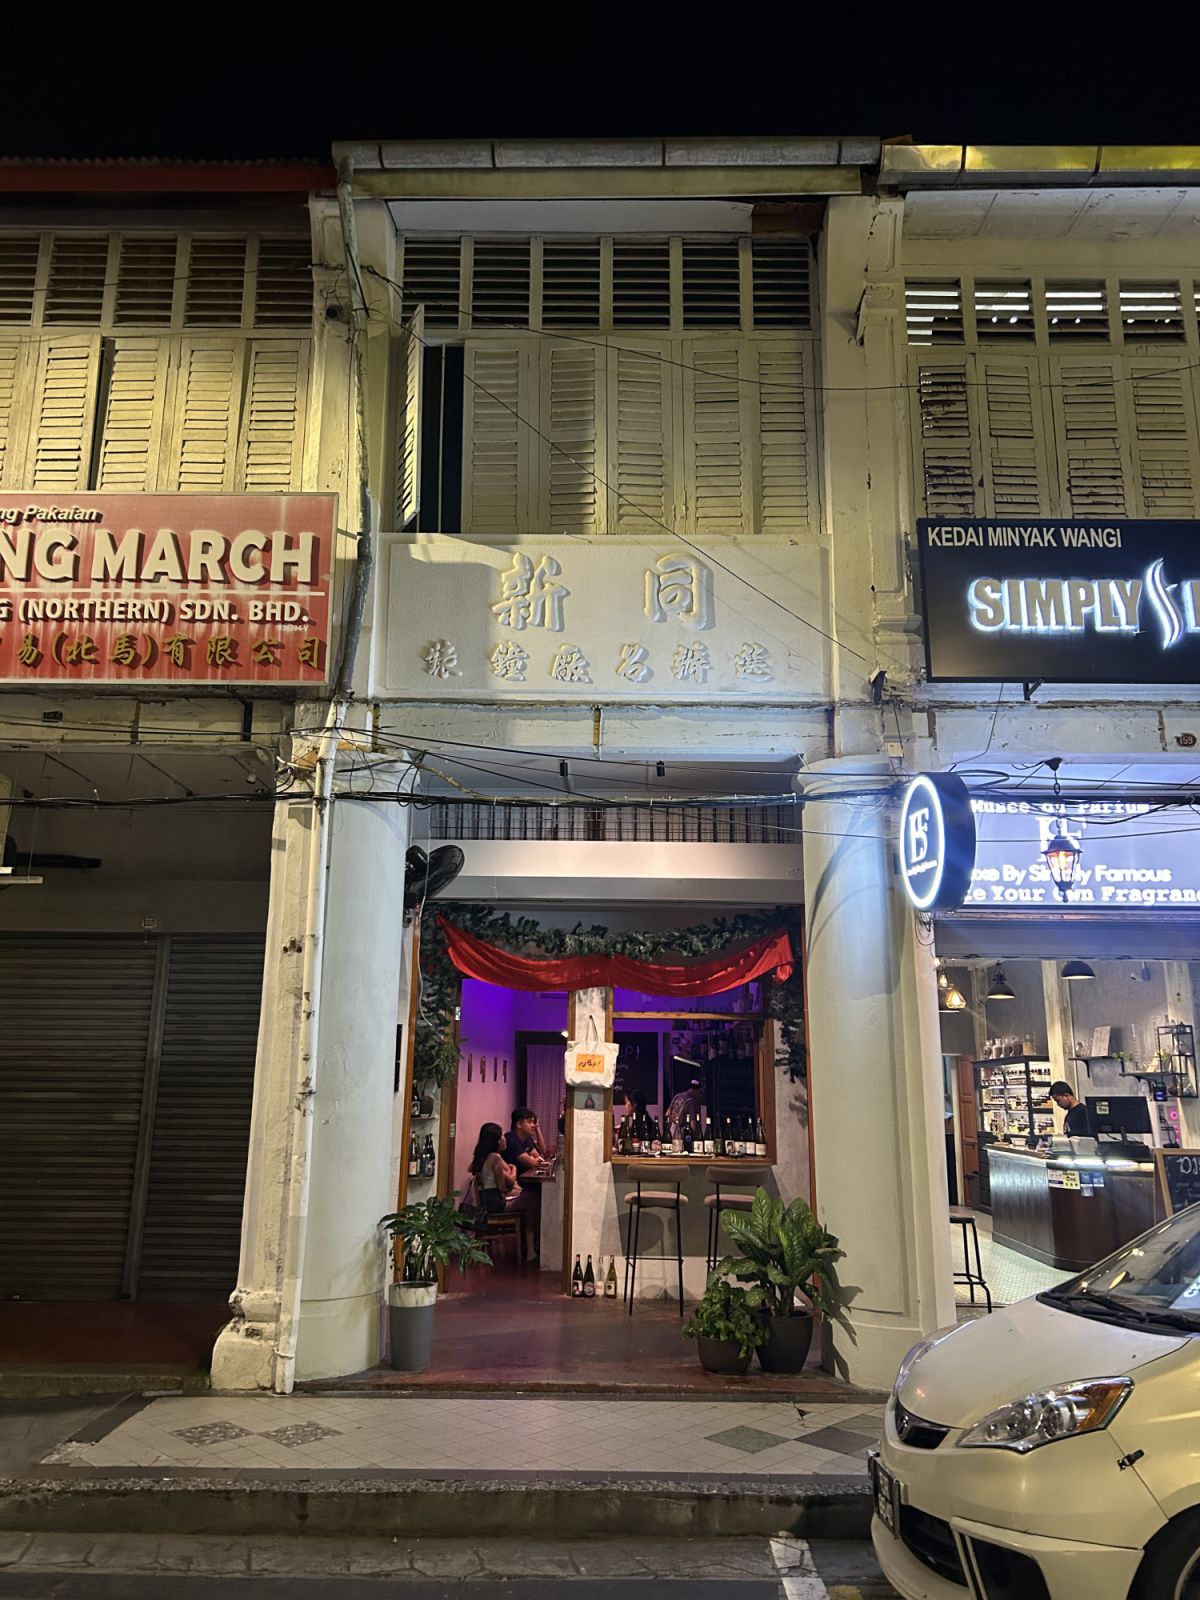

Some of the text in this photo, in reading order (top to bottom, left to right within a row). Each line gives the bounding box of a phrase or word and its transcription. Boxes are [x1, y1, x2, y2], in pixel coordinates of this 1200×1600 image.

[25, 506, 98, 521] Pakaian
[927, 527, 1122, 548] KEDAI MINYAK WANGI
[91, 529, 314, 583] MARCH
[19, 599, 169, 622] (NORTHERN)
[180, 600, 238, 620] SDN.
[249, 601, 309, 622] BHD.
[971, 577, 1143, 631] SIMPLY
[1179, 735, 1193, 746] 159
[1002, 864, 1027, 885] By
[1094, 864, 1172, 882] Famous
[990, 886, 1046, 902] Your
